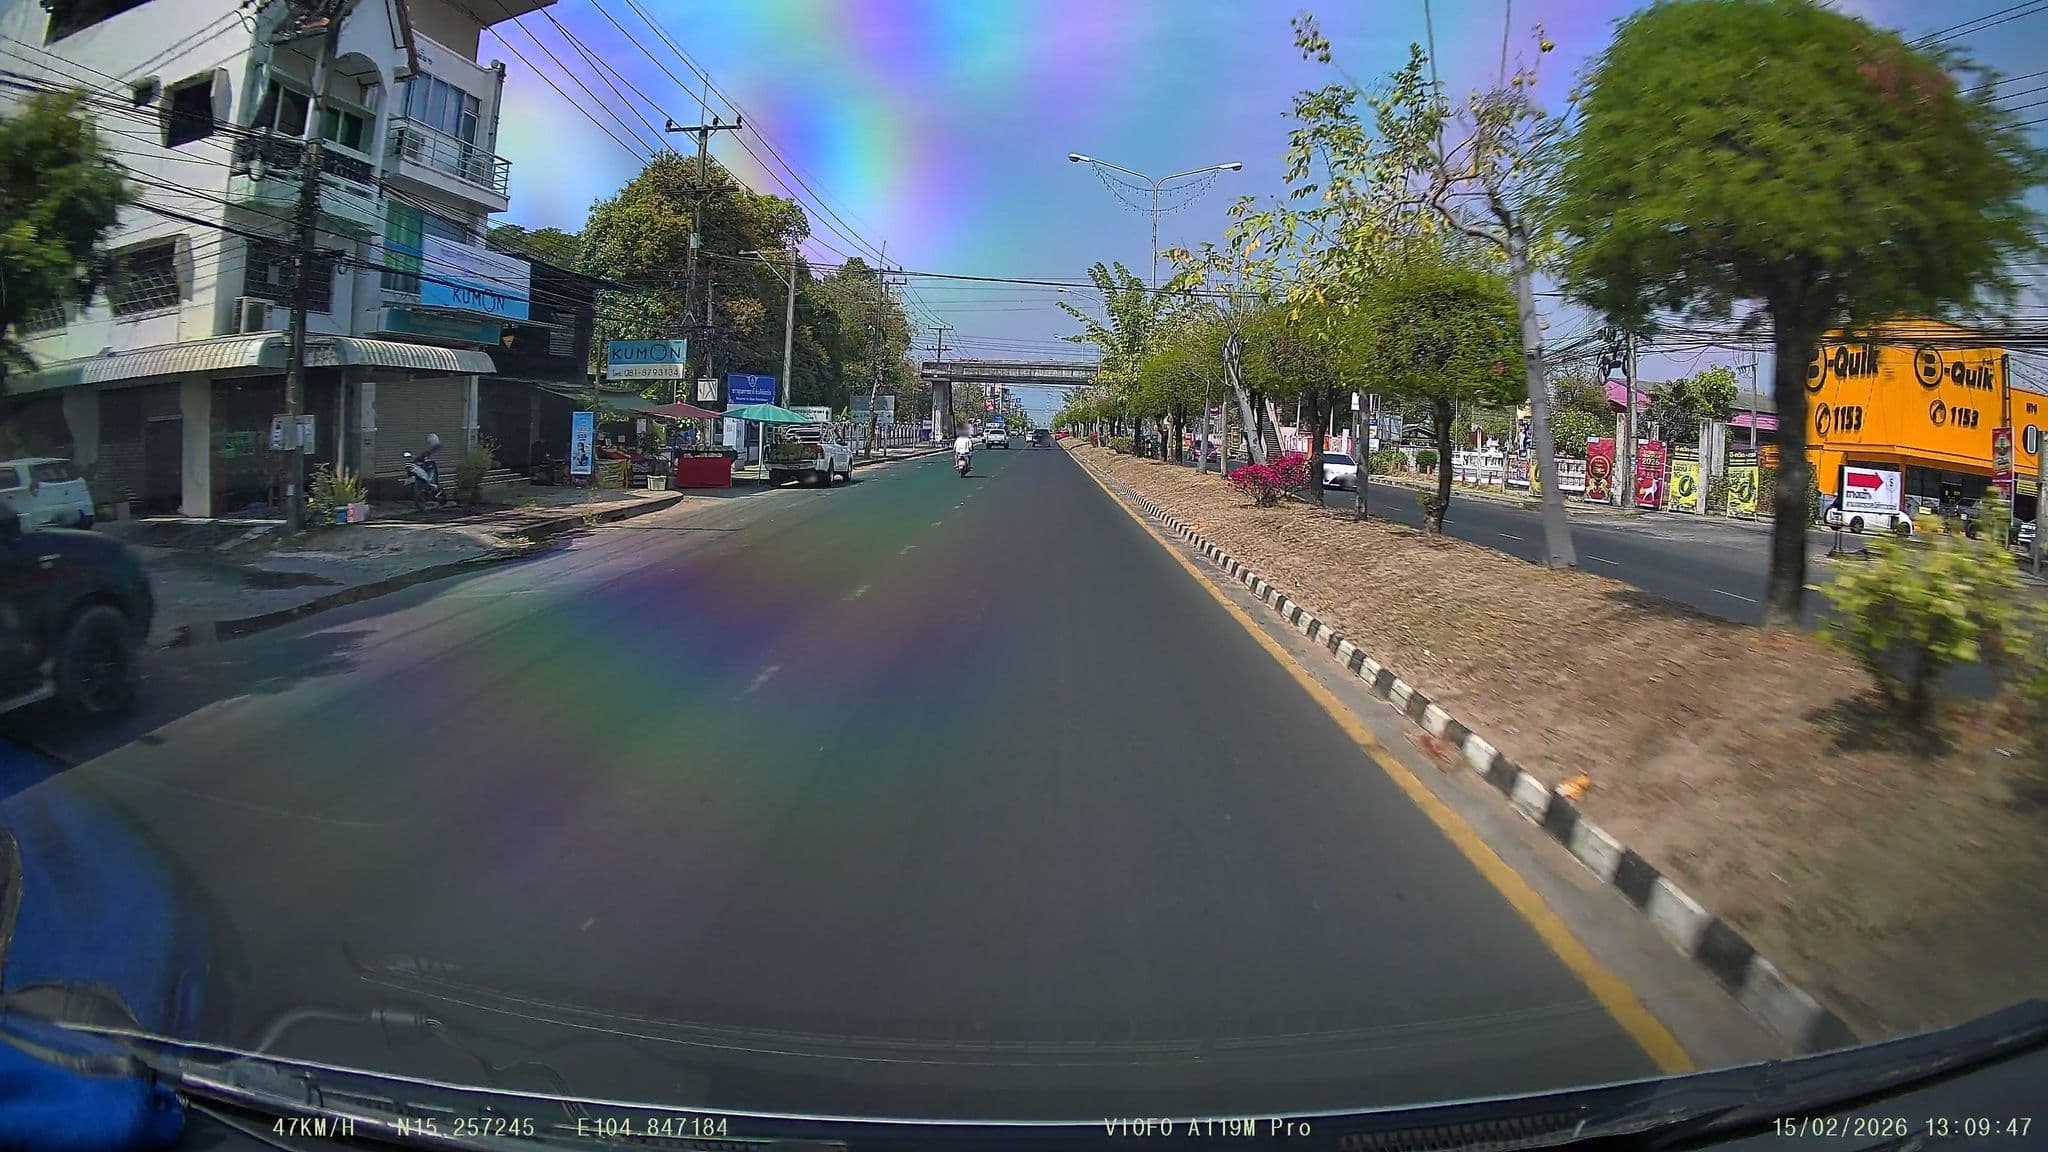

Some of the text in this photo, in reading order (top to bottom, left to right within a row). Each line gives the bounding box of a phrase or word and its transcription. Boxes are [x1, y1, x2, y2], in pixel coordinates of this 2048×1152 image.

[453, 287, 505, 312] KUMON
[612, 343, 681, 361] KUMON
[1914, 346, 1994, 392] B-Quik
[1833, 404, 1863, 433] 1153
[1950, 405, 1980, 428] 1153
[1641, 457, 1661, 466] 2026
